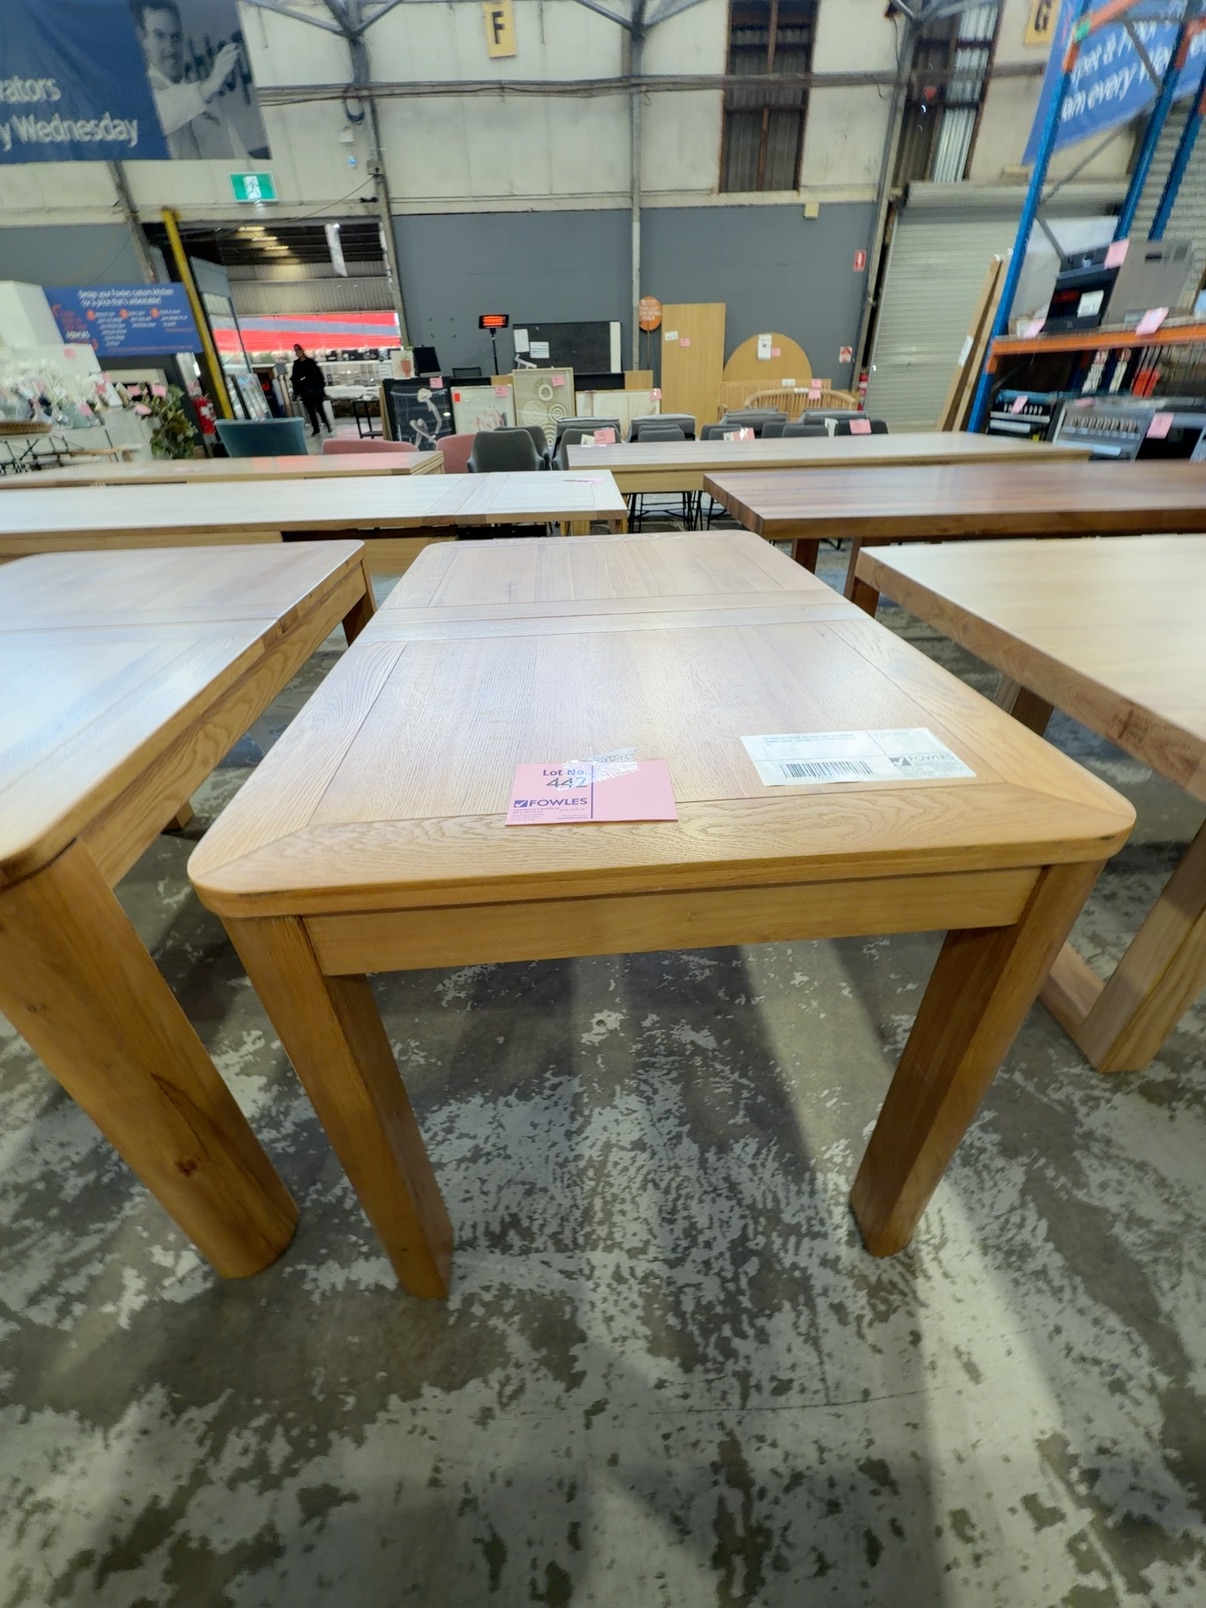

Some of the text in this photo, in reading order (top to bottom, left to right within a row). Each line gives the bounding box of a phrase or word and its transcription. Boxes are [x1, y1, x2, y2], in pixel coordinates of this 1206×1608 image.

[492, 11, 504, 45] F
[1087, 62, 1138, 110] every
[11, 112, 138, 148] Wednesday
[542, 768, 588, 777] Lot No.
[546, 777, 588, 789] 442
[528, 797, 588, 808] FOWLES
